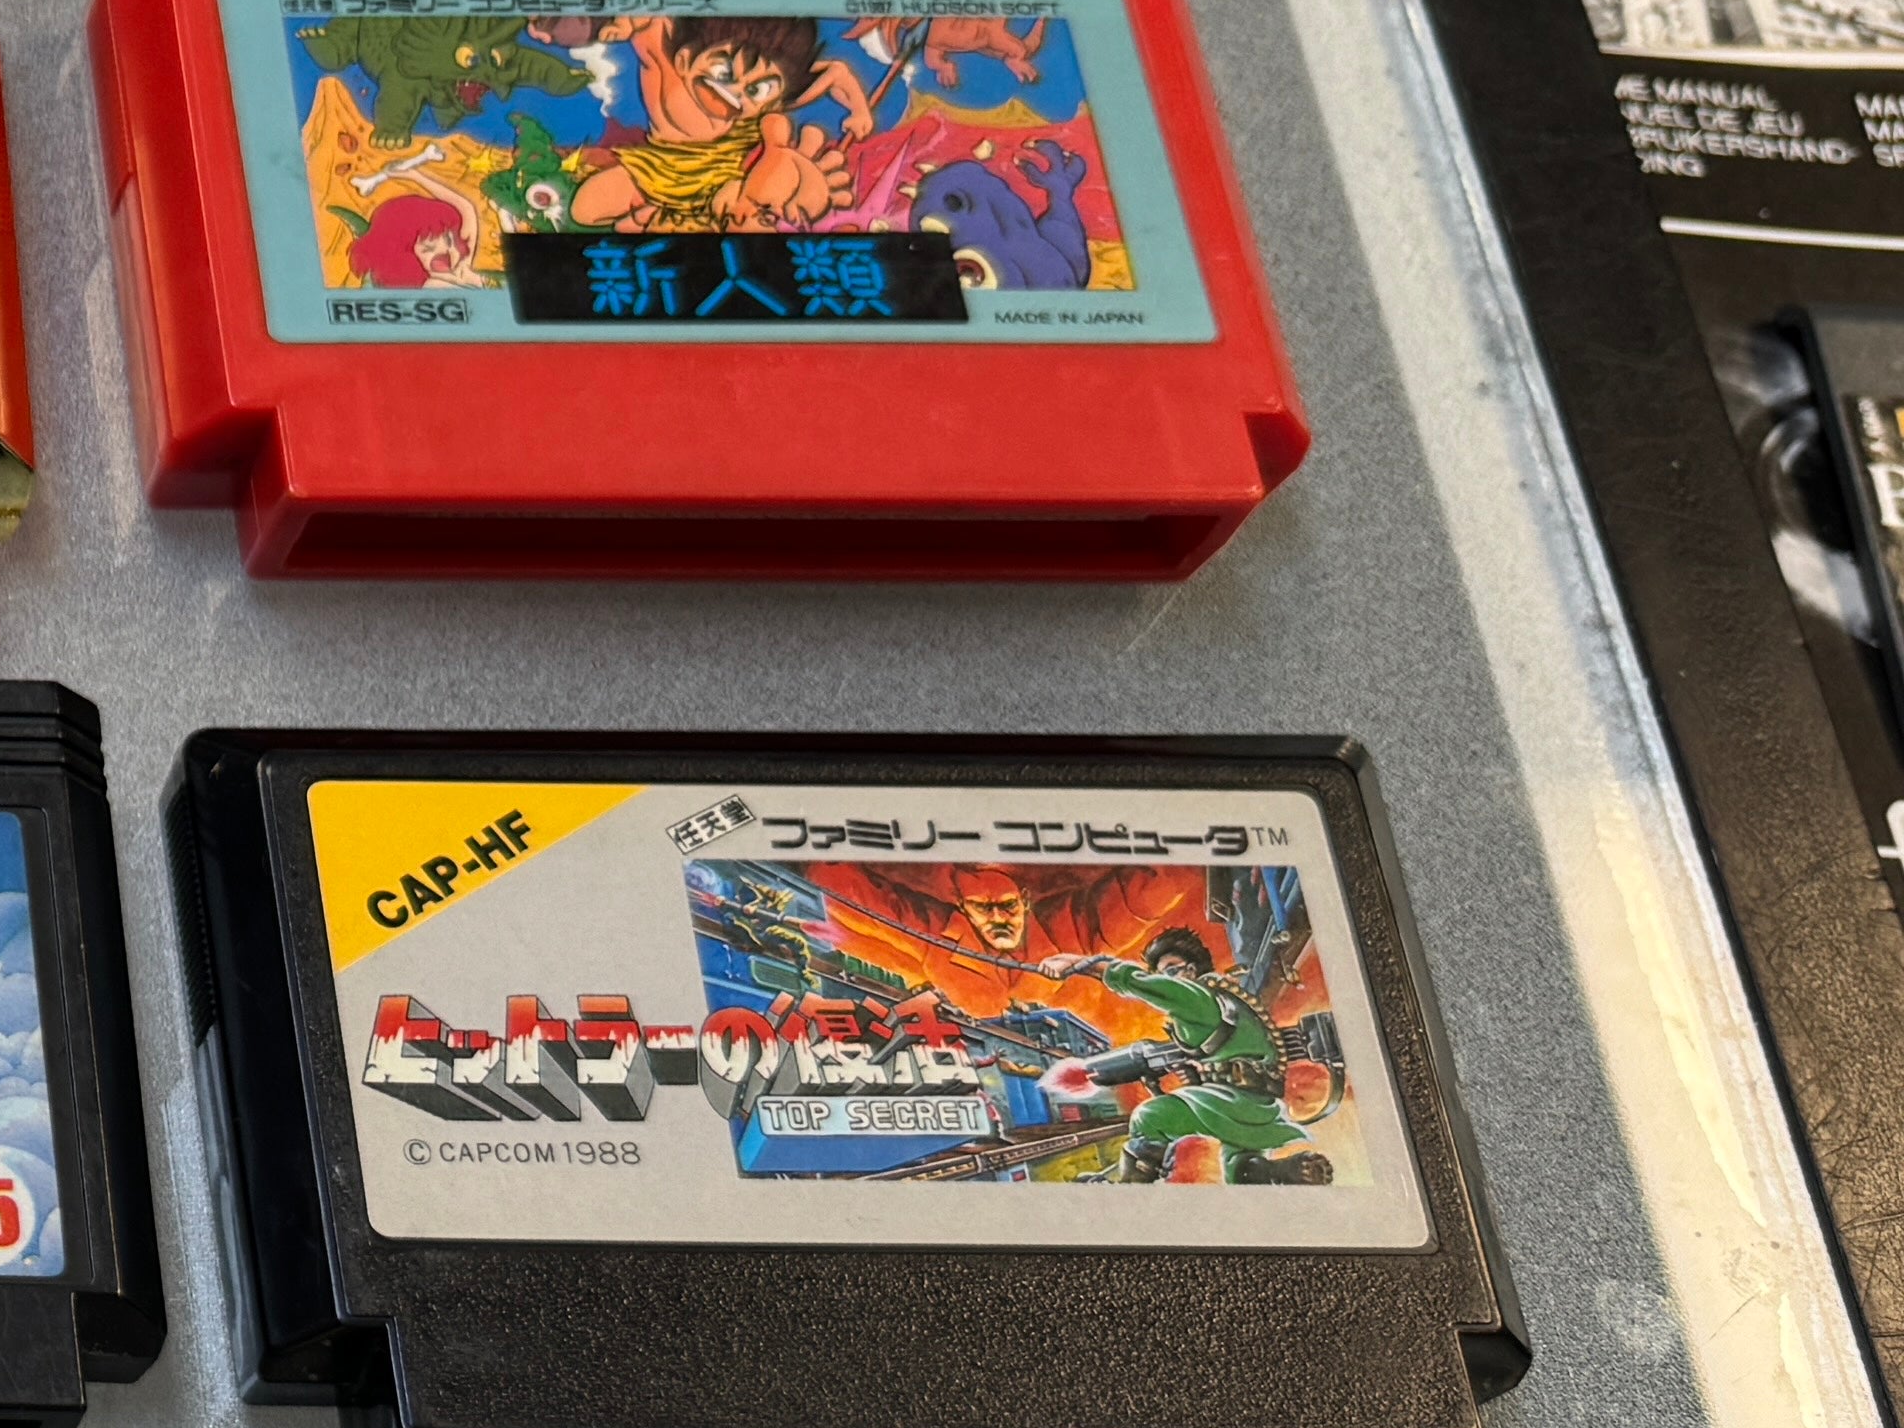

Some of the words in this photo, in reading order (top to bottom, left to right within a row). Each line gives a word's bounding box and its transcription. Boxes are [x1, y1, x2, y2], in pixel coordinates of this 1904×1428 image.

[901, 1, 995, 16] HUDSON
[1001, 1, 1061, 16] SOFT
[1652, 75, 1780, 113] MANUAL
[1694, 106, 1743, 134] DE
[1746, 110, 1806, 138] JEU
[582, 238, 892, 317] 新人類
[330, 299, 467, 323] RES-SG
[993, 311, 1050, 326] MADE
[1057, 312, 1078, 326] IN
[1083, 312, 1145, 326] JAPAN
[670, 794, 754, 851] 任天堂
[761, 816, 982, 852] ファミリー
[365, 808, 533, 929] CAP-HF
[361, 989, 982, 1120] ヒットラーの復活
[760, 1100, 830, 1132] TOP
[845, 1099, 984, 1132] SECRET
[439, 1140, 556, 1165] CAPCOM
[563, 1139, 642, 1165] 1988
